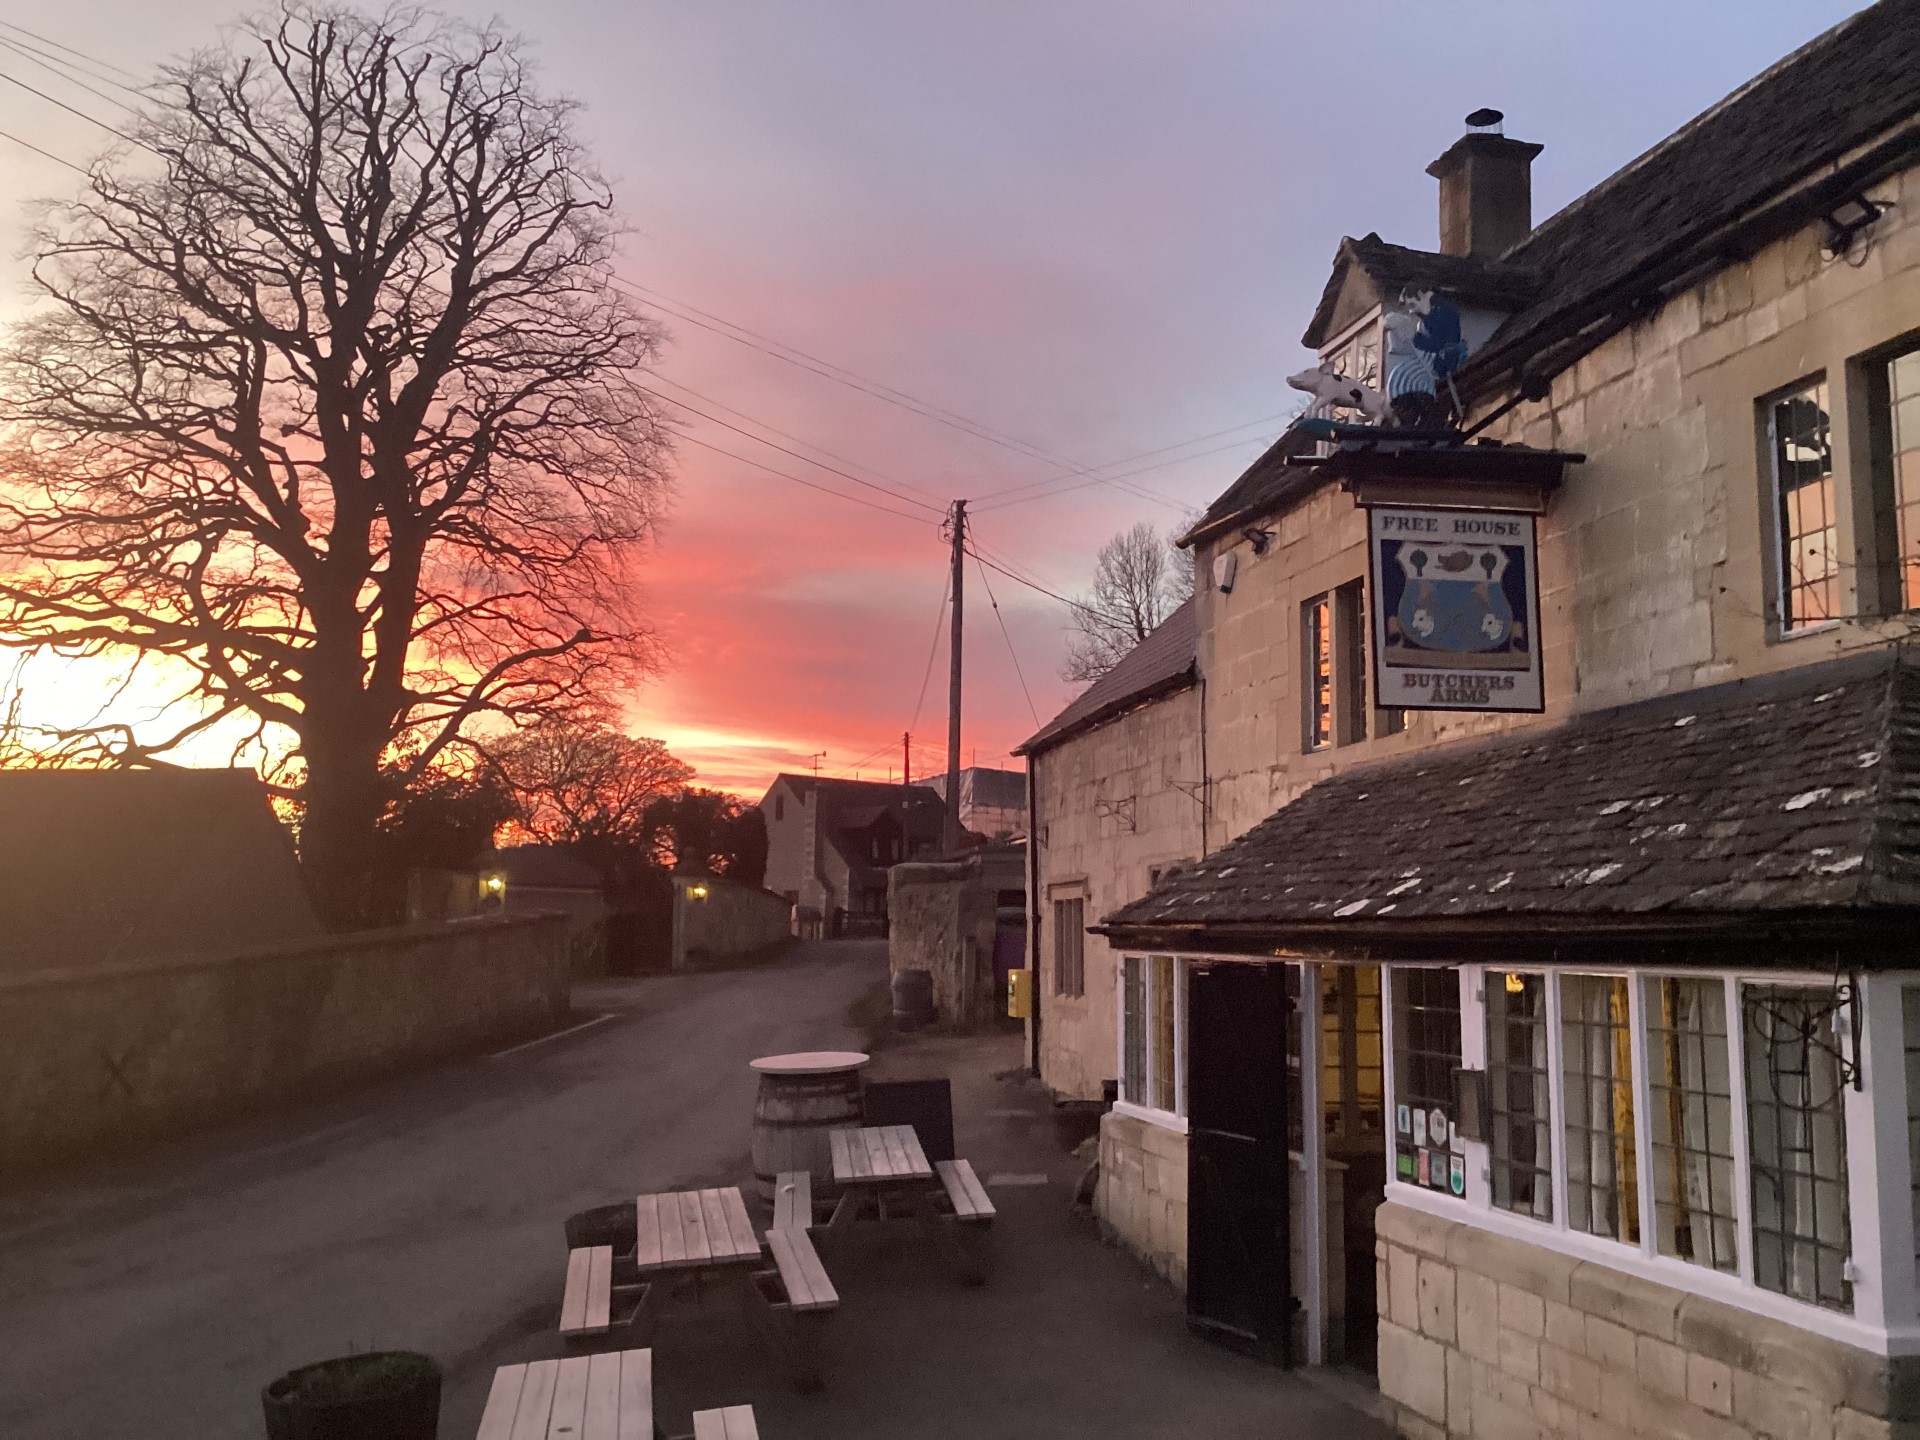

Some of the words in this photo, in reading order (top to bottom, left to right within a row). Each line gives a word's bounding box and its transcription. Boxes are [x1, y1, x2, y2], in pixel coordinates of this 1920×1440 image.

[1382, 516, 1438, 532] FREE
[1454, 519, 1521, 535] HOUSE
[1402, 673, 1515, 691] BUTCHERS
[1430, 688, 1491, 703] ARMS
